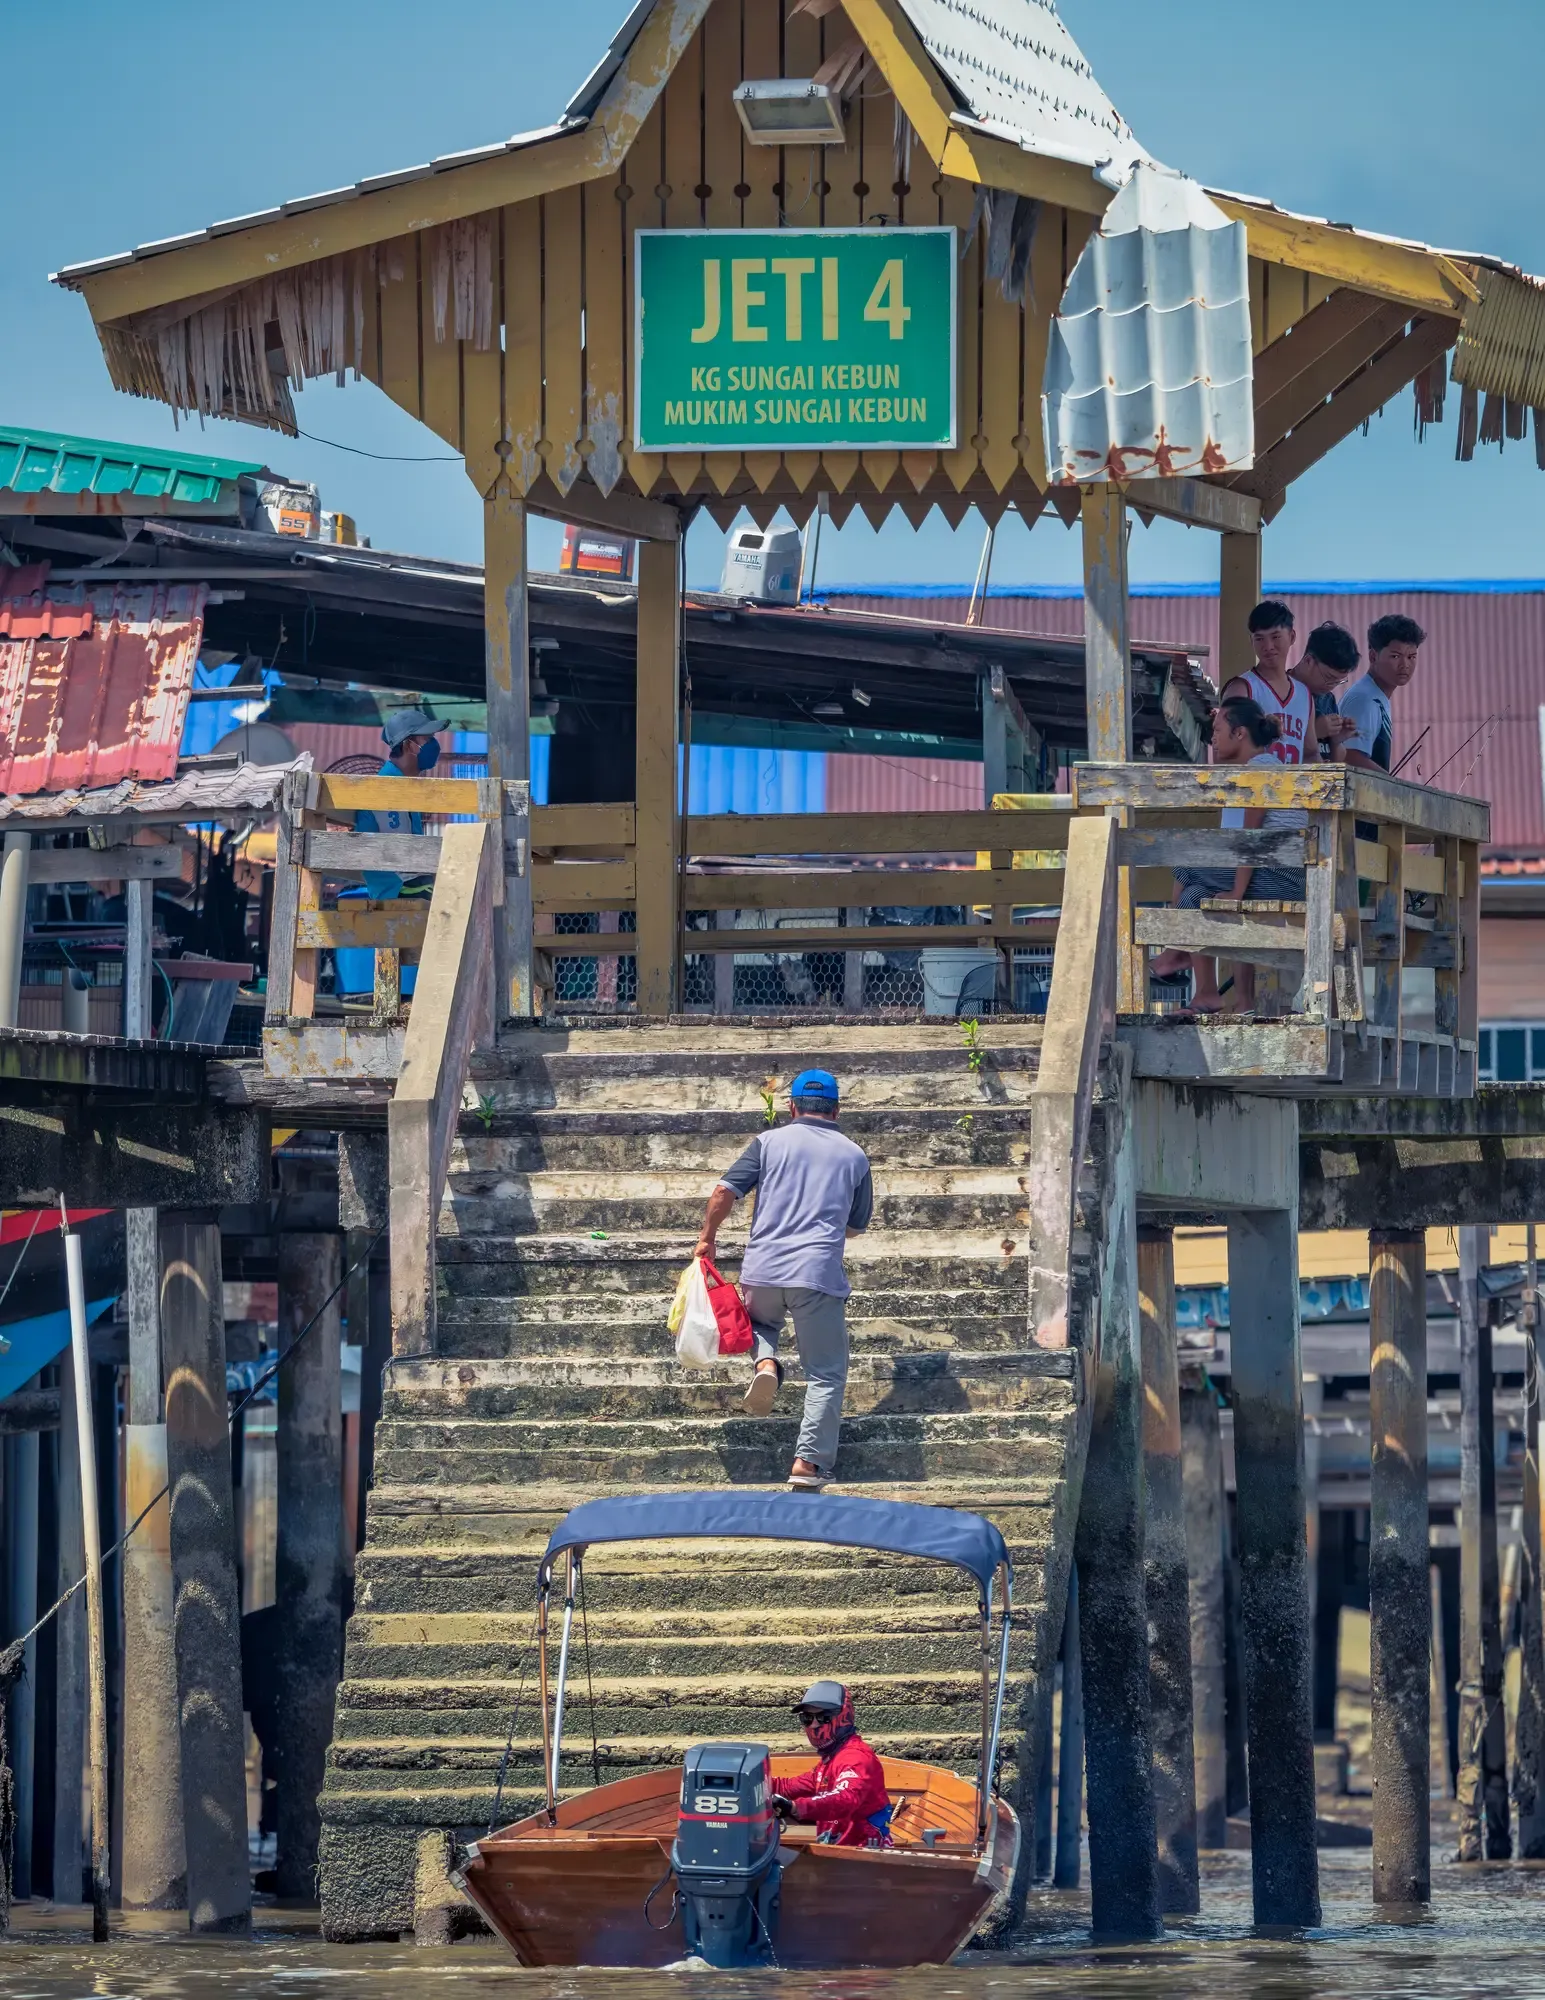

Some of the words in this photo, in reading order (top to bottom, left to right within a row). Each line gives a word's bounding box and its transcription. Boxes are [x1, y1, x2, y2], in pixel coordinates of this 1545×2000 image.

[691, 257, 838, 343] JETI
[863, 259, 911, 340] 4
[691, 367, 721, 391] KG
[728, 365, 814, 391] SUNGAI
[821, 364, 900, 389] KEBUN
[664, 400, 747, 425] MUKIM
[754, 398, 841, 424] SUNGAI
[848, 398, 927, 422] KEBUN
[280, 516, 306, 529] 55
[733, 552, 762, 565] YAMAHA
[388, 811, 400, 829] 3
[694, 1796, 740, 1815] 85
[705, 1821, 728, 1829] YAMAHA
